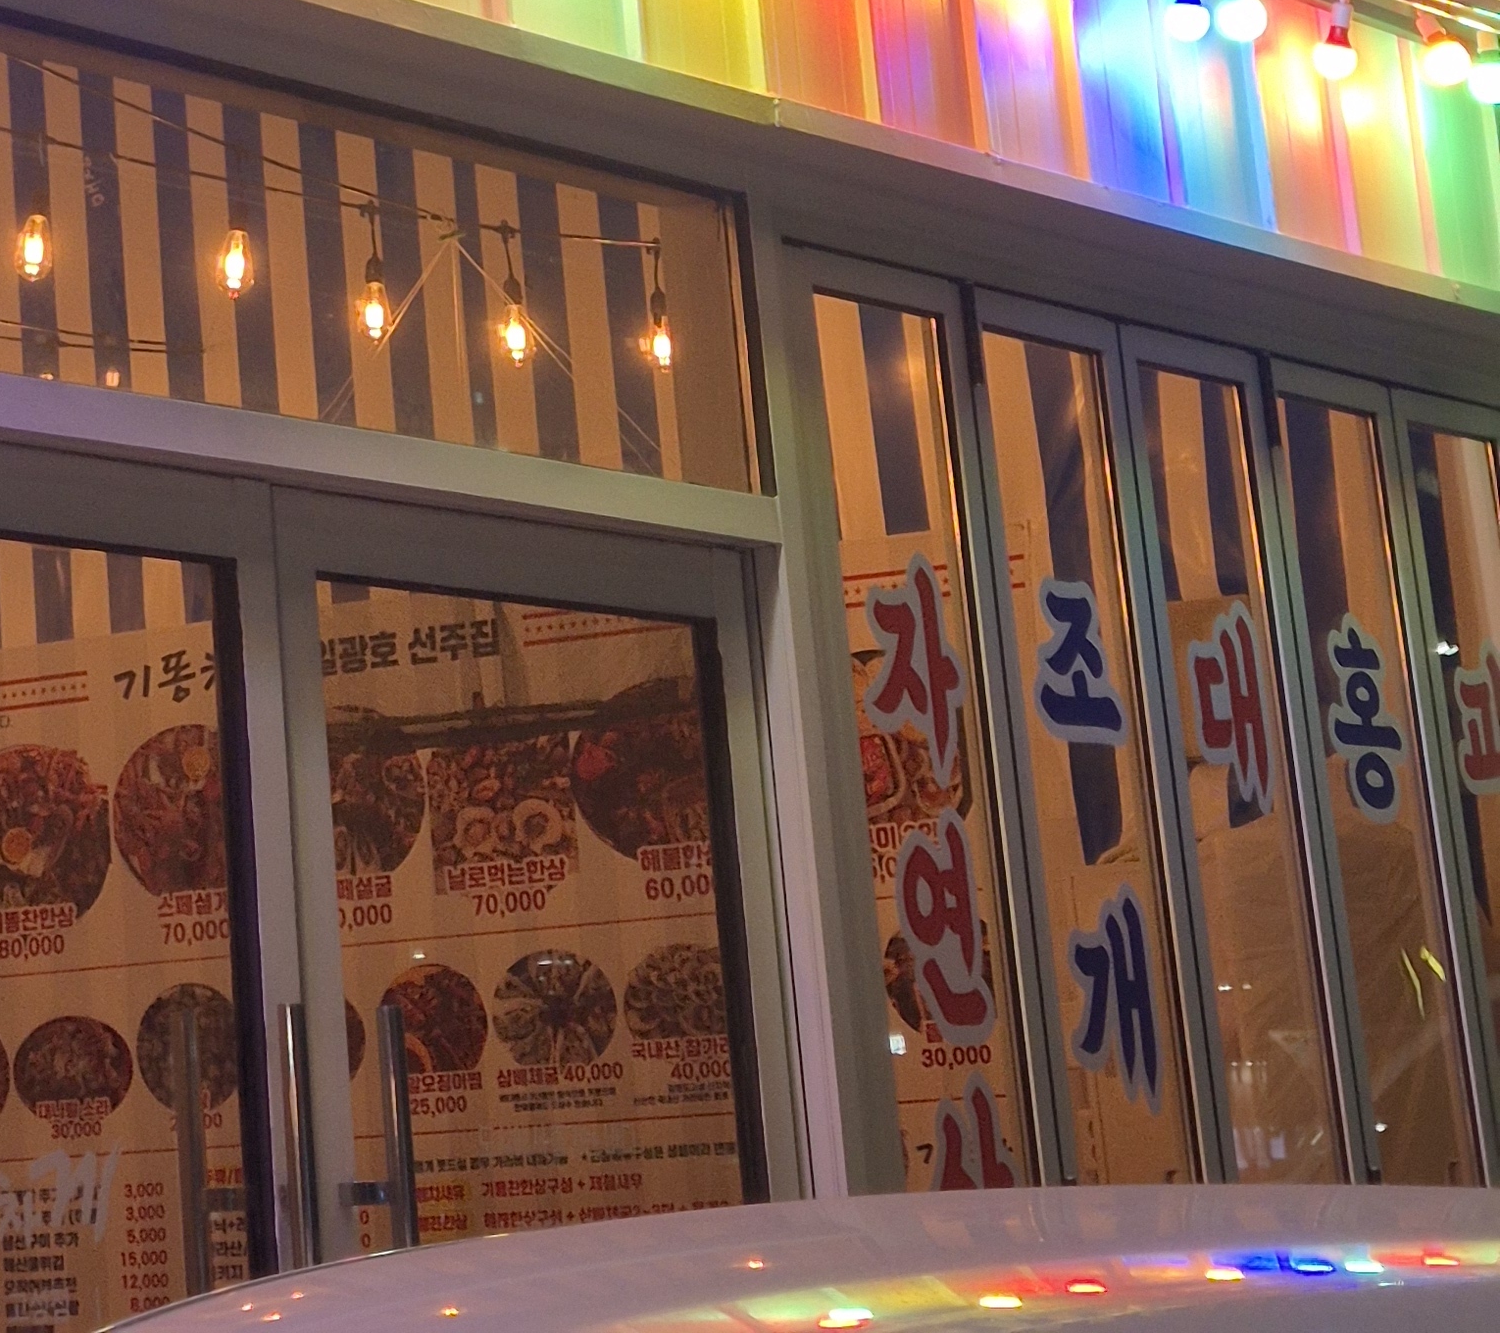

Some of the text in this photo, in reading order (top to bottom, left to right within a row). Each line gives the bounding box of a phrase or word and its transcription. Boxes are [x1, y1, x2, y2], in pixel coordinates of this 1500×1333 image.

[408, 618, 499, 666] 선주집
[1194, 615, 1269, 814] 대
[1334, 626, 1403, 808] 홍
[471, 888, 546, 918] 70,000
[921, 1045, 992, 1070] 30,000
[564, 1062, 624, 1084] 40,000
[409, 1095, 468, 1118] 25,000
[50, 1119, 102, 1141] 30,000
[120, 1249, 168, 1269] 15,000
[121, 1273, 169, 1293] 12,000
